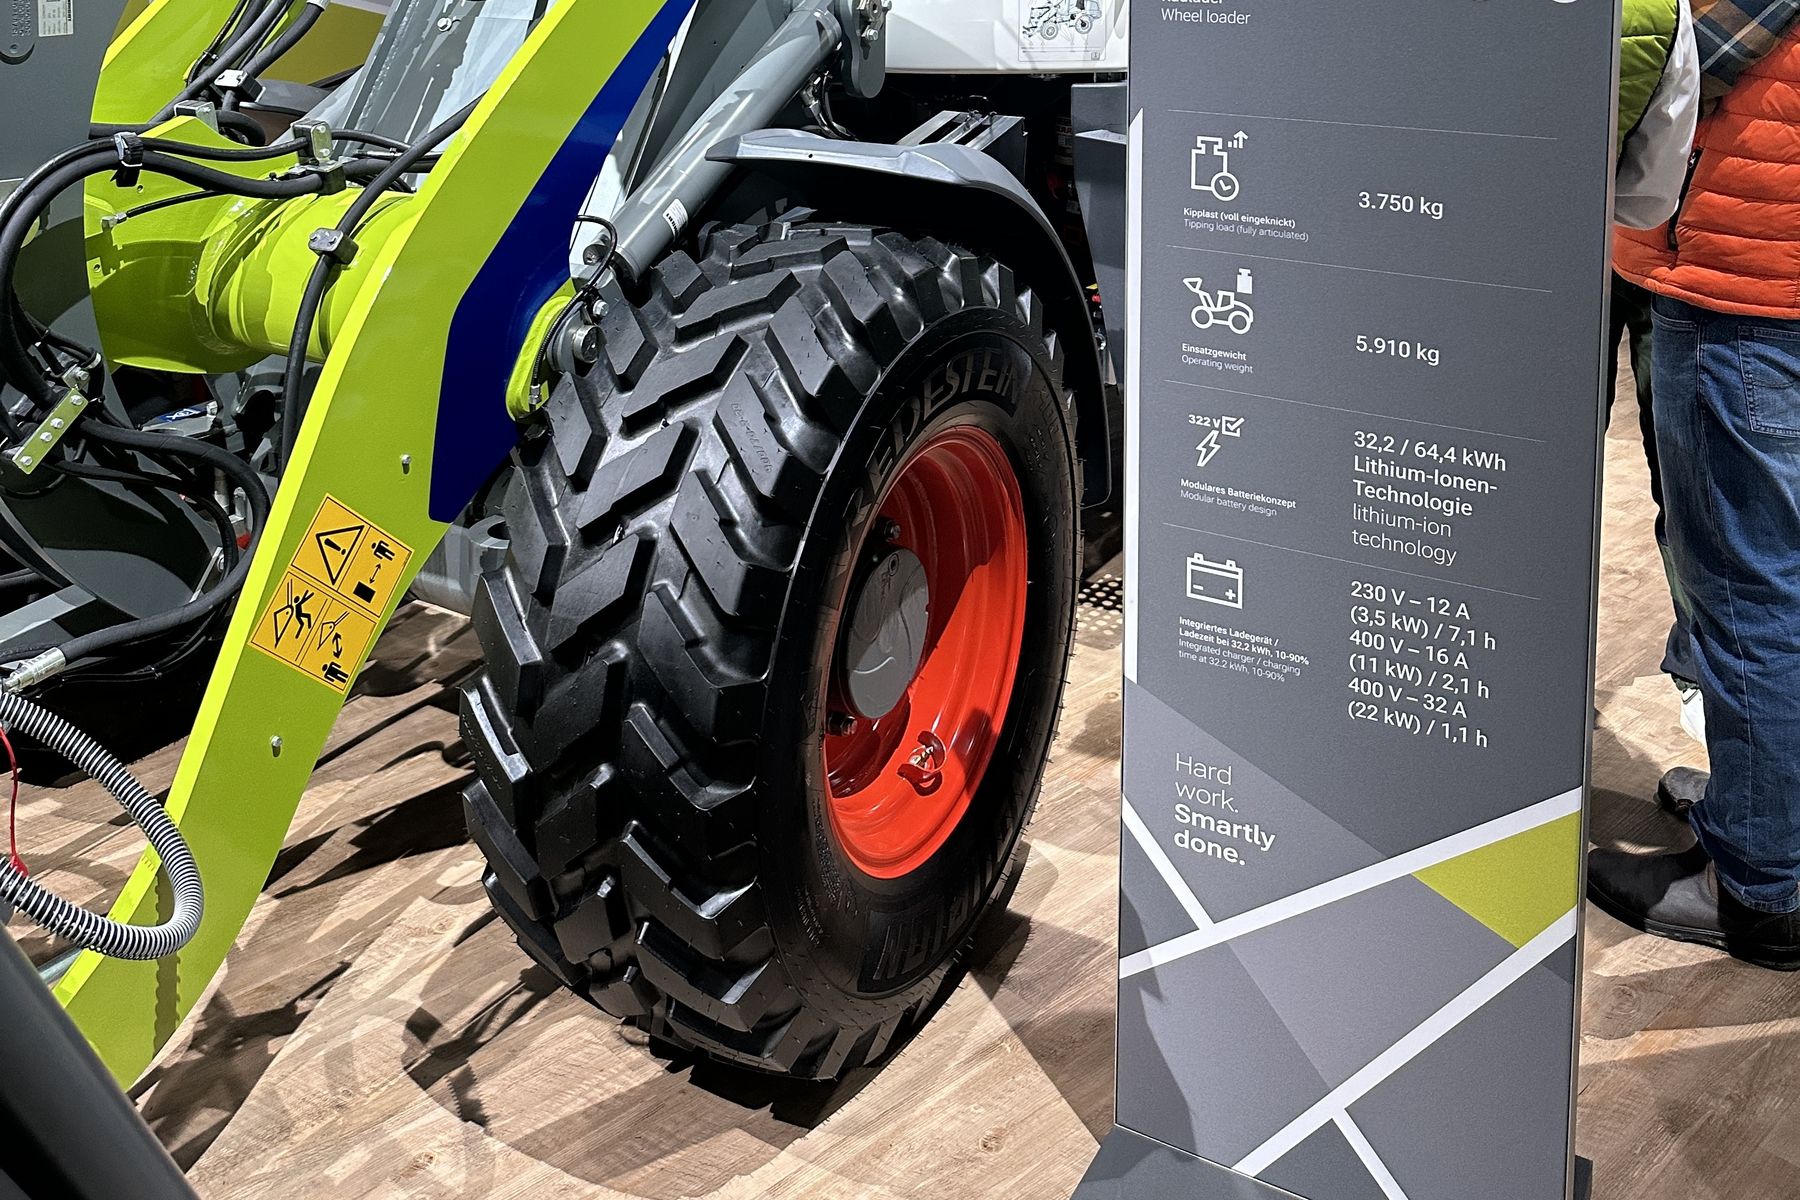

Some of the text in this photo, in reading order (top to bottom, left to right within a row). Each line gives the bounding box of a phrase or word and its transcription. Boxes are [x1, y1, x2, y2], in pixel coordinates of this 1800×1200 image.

[1161, 7, 1251, 25] Wheel loader
[1183, 207, 1296, 229] Kipplast (voll eingeknickt)
[1358, 191, 1444, 220] 3.750 kg
[1183, 218, 1309, 243] Tipping load (fully articulated)
[1181, 342, 1247, 361] Einsatzgewicht
[1181, 354, 1253, 375] Operating weight
[1355, 334, 1440, 367] 5.910 kg
[1188, 414, 1211, 427] 322
[1353, 430, 1507, 472] 32,2 / 64,4 kWh
[1354, 455, 1498, 494] Lithium-Ionen-
[1180, 478, 1297, 510] Modulares Batteriekonzept
[1180, 489, 1277, 517] Modular battery design
[1352, 479, 1473, 517] Technologie
[1352, 502, 1452, 538] lithium-ion
[1351, 529, 1457, 567] technology
[1350, 580, 1386, 602] 230
[1391, 588, 1406, 606] V
[1427, 596, 1451, 616] 12
[1455, 602, 1470, 621] A
[1179, 616, 1228, 635] Integriertes
[1229, 628, 1273, 646] Ladegerät
[1350, 605, 1496, 650] (3,5 kW) / 7,1 h
[1179, 627, 1215, 643] Ladezeit
[1216, 635, 1230, 647] bei
[1231, 639, 1250, 653] 32,2
[1275, 650, 1310, 666] 10-90%
[1179, 638, 1221, 656] Integrated
[1222, 648, 1255, 665] charger
[1262, 658, 1301, 676] charging
[1349, 629, 1385, 650] 400
[1389, 636, 1404, 654] V
[1425, 645, 1449, 665] 16
[1453, 652, 1469, 670] A
[1178, 650, 1198, 662] time
[1198, 655, 1208, 664] at
[1252, 666, 1285, 682] 10-90%
[1349, 653, 1489, 699] (11 kW) / 2,1 h
[1348, 677, 1384, 698] 400
[1388, 684, 1403, 702] V
[1422, 693, 1448, 714] 32
[1452, 701, 1468, 719] A
[1348, 700, 1488, 748] (22 kW) / 1,1 h
[1175, 752, 1232, 786] Hard
[1175, 781, 1239, 814] work.
[1174, 803, 1276, 852] Smartly
[1173, 829, 1246, 866] done.
